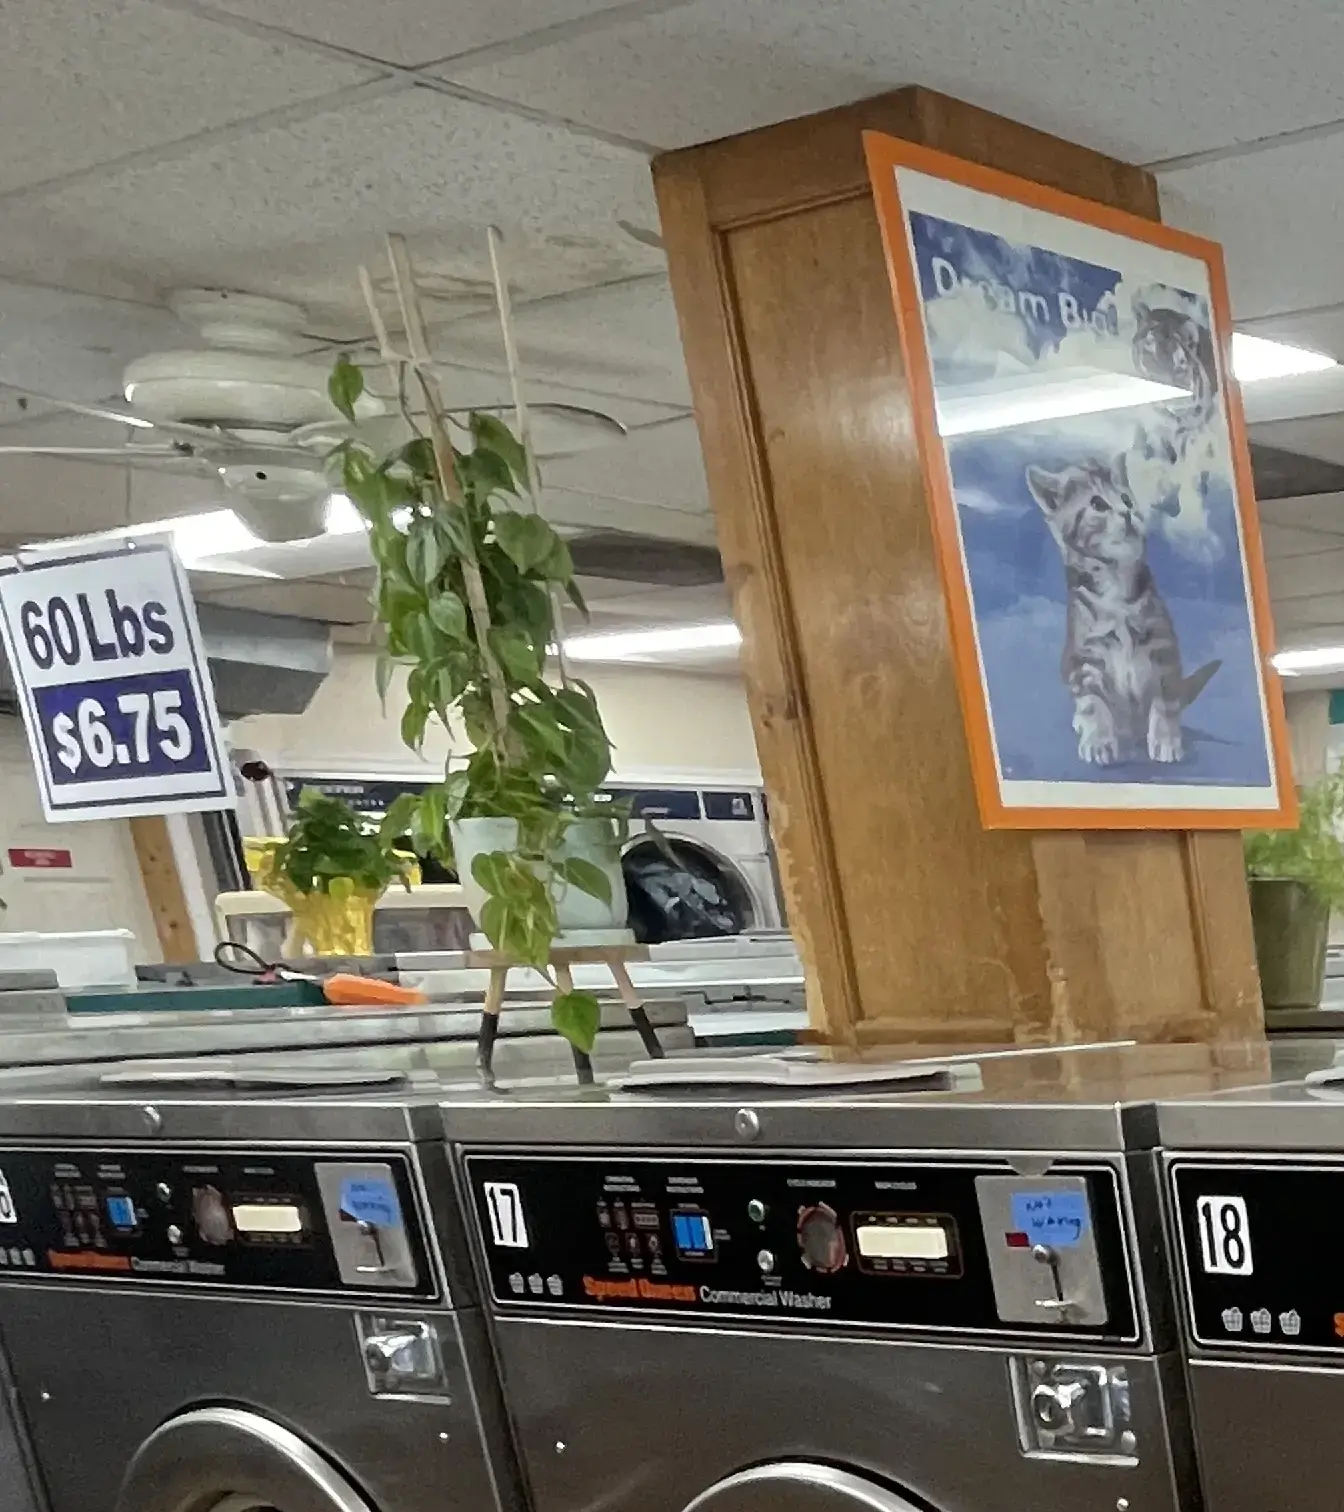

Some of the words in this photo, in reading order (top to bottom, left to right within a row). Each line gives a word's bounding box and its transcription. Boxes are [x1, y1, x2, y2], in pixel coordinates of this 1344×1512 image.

[52, 690, 193, 774] $6.75
[488, 1185, 519, 1244] 17
[1202, 1201, 1246, 1270] 18
